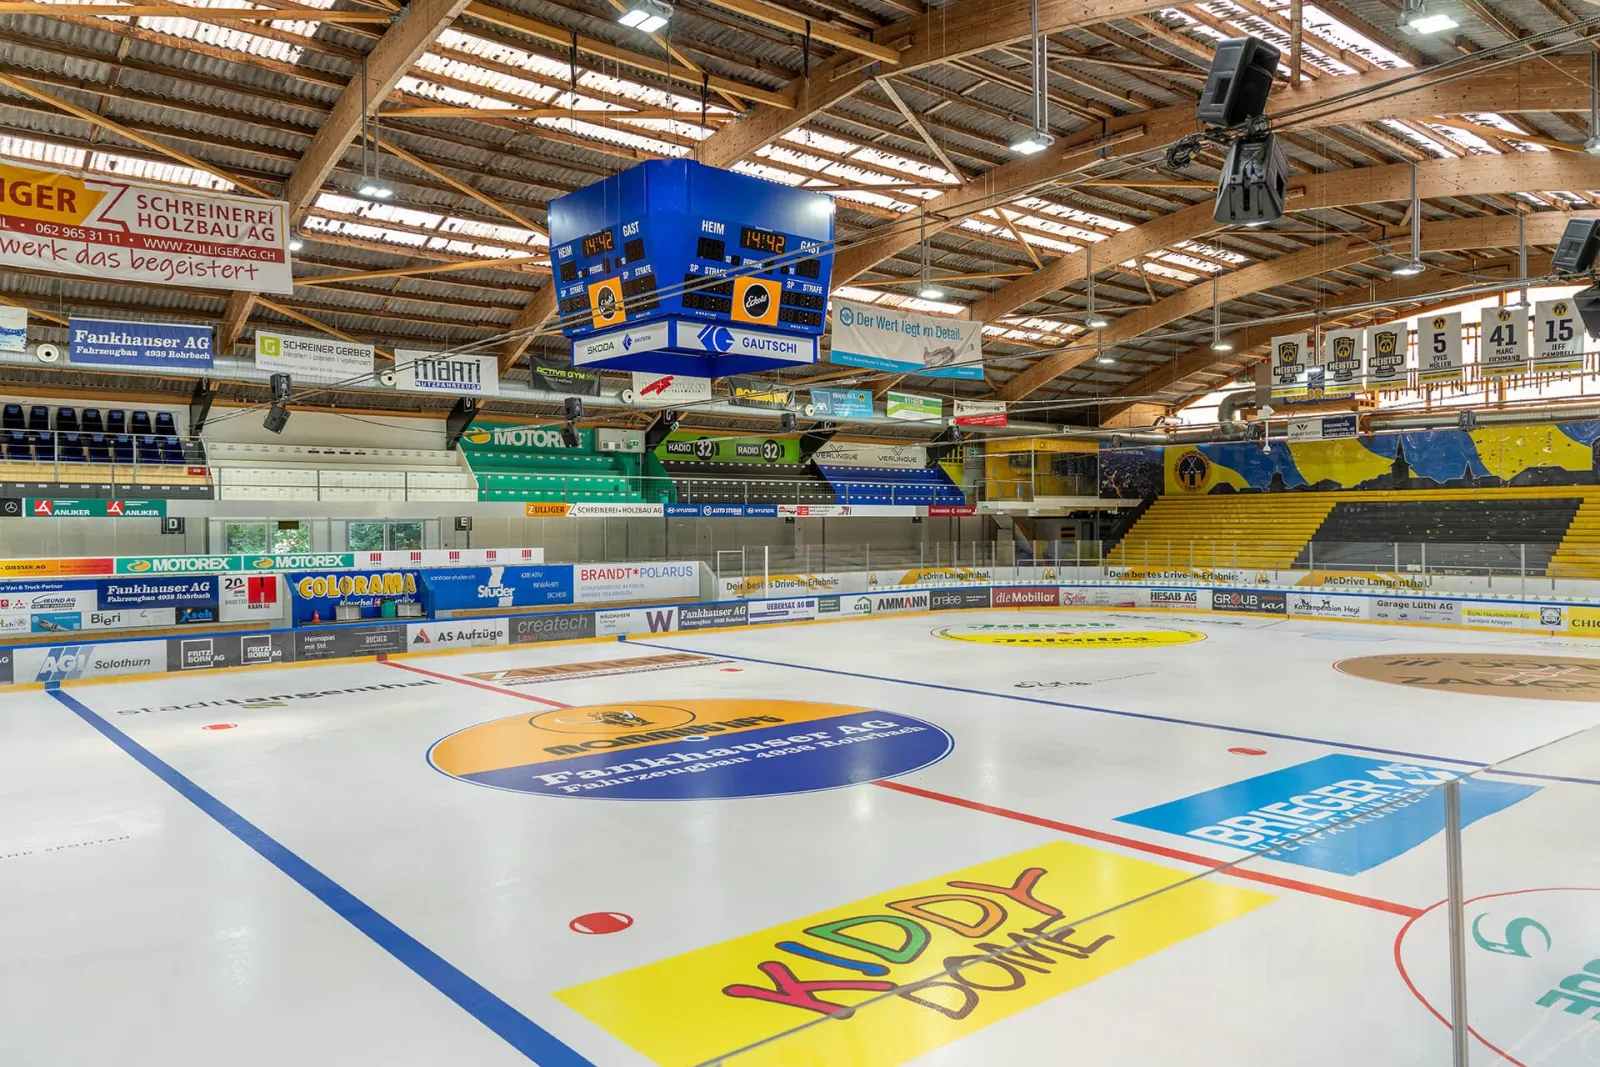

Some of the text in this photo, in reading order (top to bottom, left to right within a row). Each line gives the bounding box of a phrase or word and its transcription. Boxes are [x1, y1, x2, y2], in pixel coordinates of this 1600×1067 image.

[137, 194, 274, 226] SCHREINEREI
[137, 212, 275, 242] HOLZBAU AG
[622, 221, 640, 237] GAST
[702, 220, 725, 235] HEIM
[35, 222, 276, 261] 062 965 31 11 WWW.ZULLIGERAG.CH
[585, 231, 613, 255] 14:42
[746, 230, 785, 254] 14:42
[558, 245, 573, 259] HEIM
[75, 242, 121, 269] das
[130, 248, 259, 281] begeistert
[690, 264, 699, 273] SP
[803, 283, 823, 294] STRAFE
[856, 312, 874, 327] Der
[876, 315, 899, 334] Wert
[901, 319, 921, 338] liegt
[936, 325, 963, 342] Detail.
[1545, 319, 1573, 342] 15
[74, 329, 210, 350] Fankhauser AG
[1489, 324, 1517, 346] 41
[283, 340, 371, 358] SCHREINER GERBER
[742, 336, 798, 354] GAUTSCHI
[1433, 333, 1446, 353] 5
[76, 345, 210, 360] Fahrzeugbau 4938 Rohrbach
[283, 350, 308, 359] beraten
[313, 354, 336, 363] planen
[1329, 361, 1359, 370] MEISTER
[1370, 356, 1401, 366] MEISTER
[567, 371, 585, 379] GYM
[1274, 365, 1303, 374] MEISTER
[415, 380, 481, 390] NUTZFAHRZEUGE
[815, 401, 828, 411] AXA
[494, 428, 583, 449] MOTOR
[668, 440, 713, 457] RADIO 32
[738, 443, 778, 458] RADIO 32
[877, 455, 917, 463] VERLINGUE
[125, 509, 159, 517] ANLIKER
[528, 505, 565, 514] ZULLIGER
[169, 518, 178, 529] D
[153, 557, 230, 572] MOTOREX
[275, 555, 344, 568] MOTOREX
[1109, 570, 1129, 579] Den
[107, 582, 210, 595] Fankhauser AG
[225, 577, 243, 589] 20
[299, 573, 416, 599] COLORAMA
[533, 581, 559, 589] BEWÄHRT
[747, 581, 773, 590] bests
[1324, 576, 1366, 588] McDrive
[107, 595, 155, 603] Fahrzeugbau
[177, 592, 210, 600] Rohrbach
[478, 584, 515, 598] Studer
[996, 592, 1055, 603] die Mobiliar
[1150, 592, 1197, 602] HESAB AG
[766, 602, 796, 611] UEBERSAX
[878, 596, 927, 610] AMMANN
[1344, 605, 1360, 614] Hegi
[1377, 600, 1453, 611] Garage Lüthi AG
[91, 613, 121, 625] Bieri
[681, 606, 746, 619] Fankhauser AG
[517, 615, 588, 634] createch
[646, 610, 673, 633] W
[304, 635, 335, 643] Heimspiel
[438, 628, 503, 642] AS Aufzüge
[247, 651, 270, 659] BORN
[39, 653, 151, 674] AGI Solothurn
[532, 718, 900, 787] Fankhauser AG
[557, 724, 928, 794] Fahrzeugbau 4938 Rohrbach
[1186, 779, 1405, 848] BRIEGER
[722, 867, 1066, 1020] KIDDY
[896, 914, 1116, 1021] DOME
